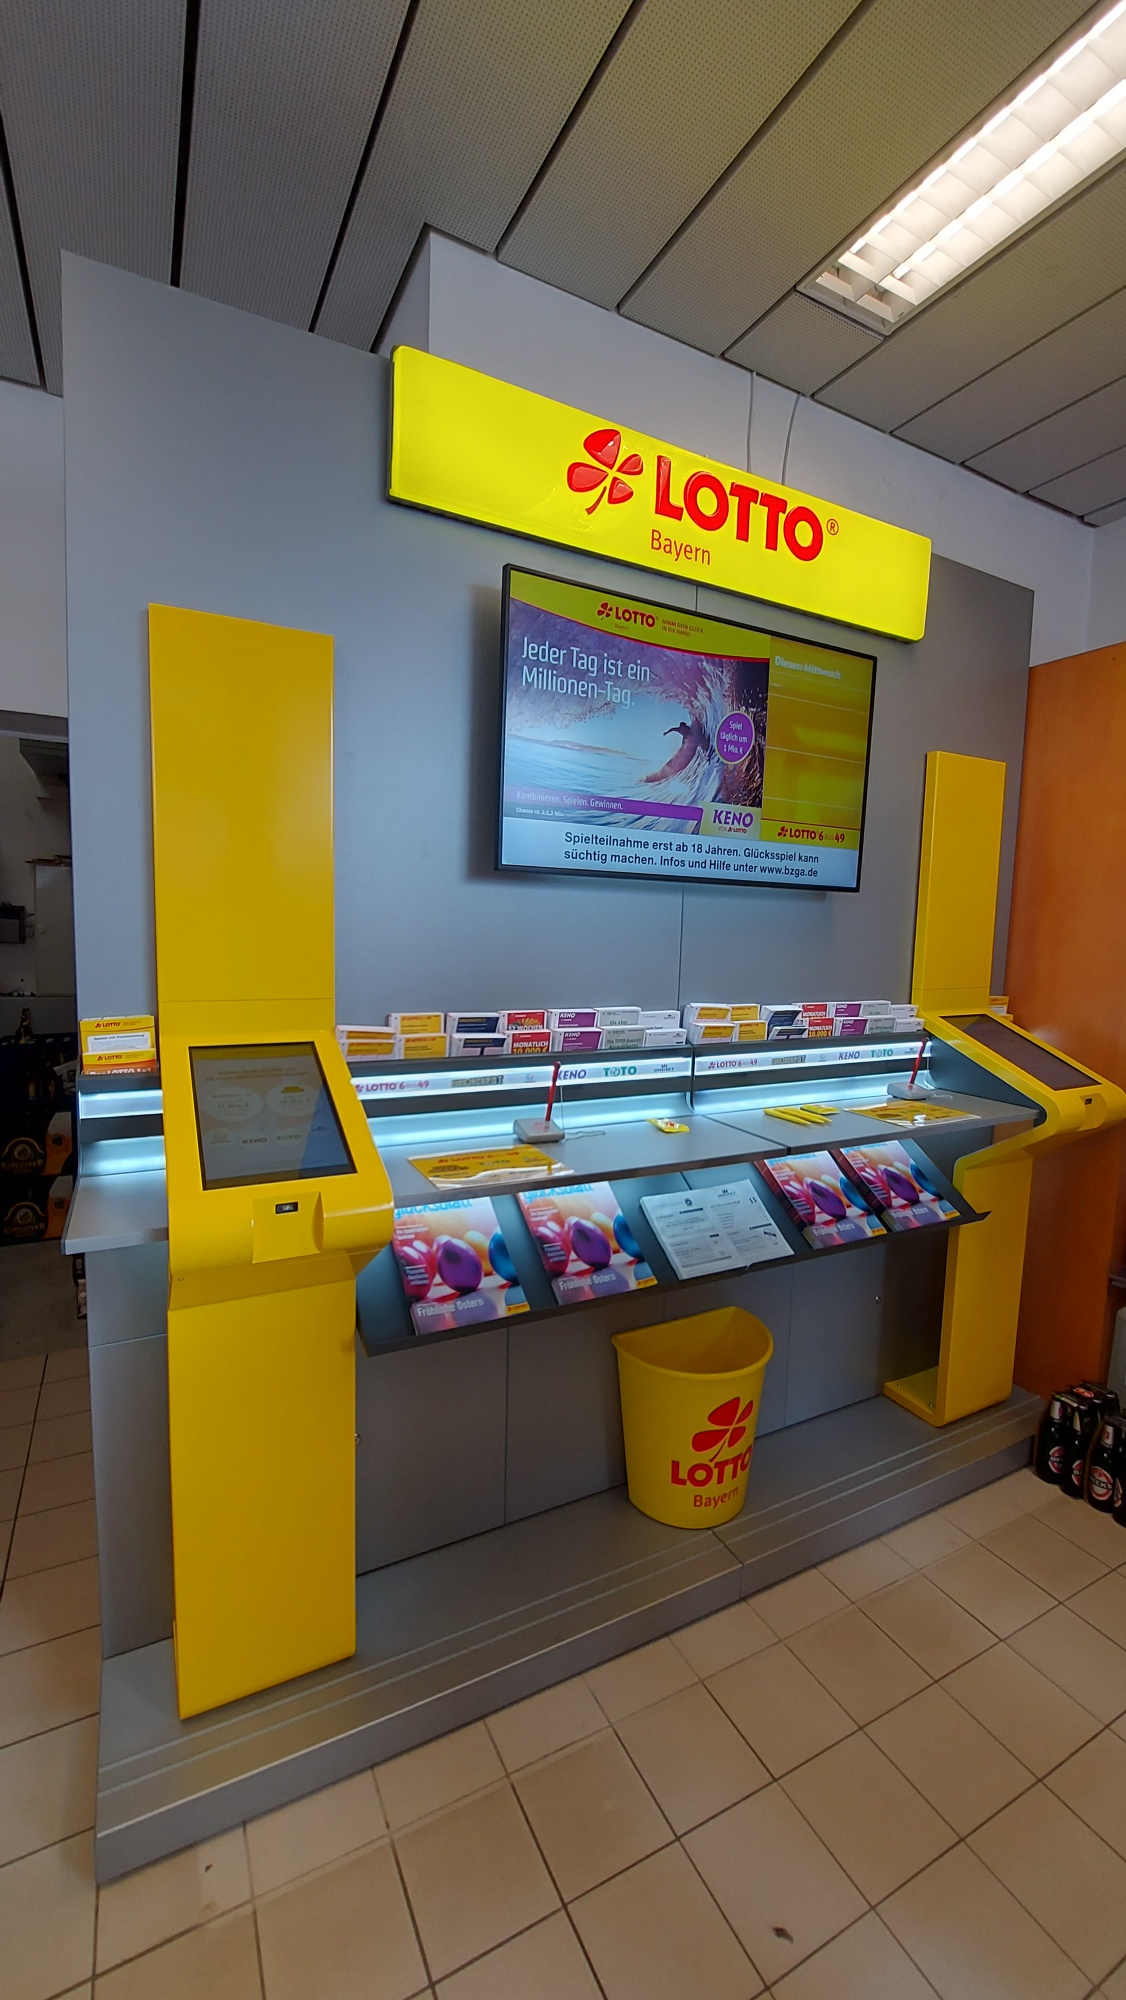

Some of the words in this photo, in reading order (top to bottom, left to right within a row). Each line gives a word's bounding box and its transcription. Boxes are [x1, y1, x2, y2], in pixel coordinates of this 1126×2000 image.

[650, 528, 711, 566] Bayern
[615, 606, 656, 628] LOTTO
[522, 637, 567, 666] Jeder
[570, 647, 598, 677] Tag
[603, 653, 623, 678] ist
[627, 660, 650, 682] ein
[774, 655, 803, 671] Diesen
[803, 663, 841, 680] Mittwoch
[522, 665, 635, 710] Millionen-Tag.
[729, 720, 743, 731] Spiel
[720, 732, 739, 742] täglich
[516, 790, 561, 804] Kombinieren.
[562, 795, 589, 807] Spielen.
[590, 798, 624, 810] Gewinnen.
[713, 809, 754, 828] KENO
[789, 828, 816, 841] LOTTO
[564, 831, 649, 850] Spielteilnahme
[652, 841, 674, 852] erst
[675, 842, 688, 854] ab
[691, 843, 703, 854] 18
[705, 844, 741, 857] Jahren.
[743, 847, 796, 862] Glücksspiel
[798, 853, 819, 864] kann
[564, 848, 607, 864] süchtig
[610, 853, 657, 866] machen.
[660, 855, 686, 868] Infos
[688, 859, 707, 870] und
[709, 860, 731, 871] Hilfe
[733, 863, 758, 873] unter
[760, 865, 818, 878] www.bzga.de
[716, 1060, 736, 1068] LOTTO
[838, 1051, 860, 1060] KENO
[366, 1082, 396, 1092] LOTTO
[593, 1272, 617, 1285] Ostern
[417, 1304, 456, 1317] Fröhliche
[456, 1297, 484, 1311] Ostern
[671, 1444, 753, 1488] LOTTO
[693, 1487, 739, 1509] Bayern
